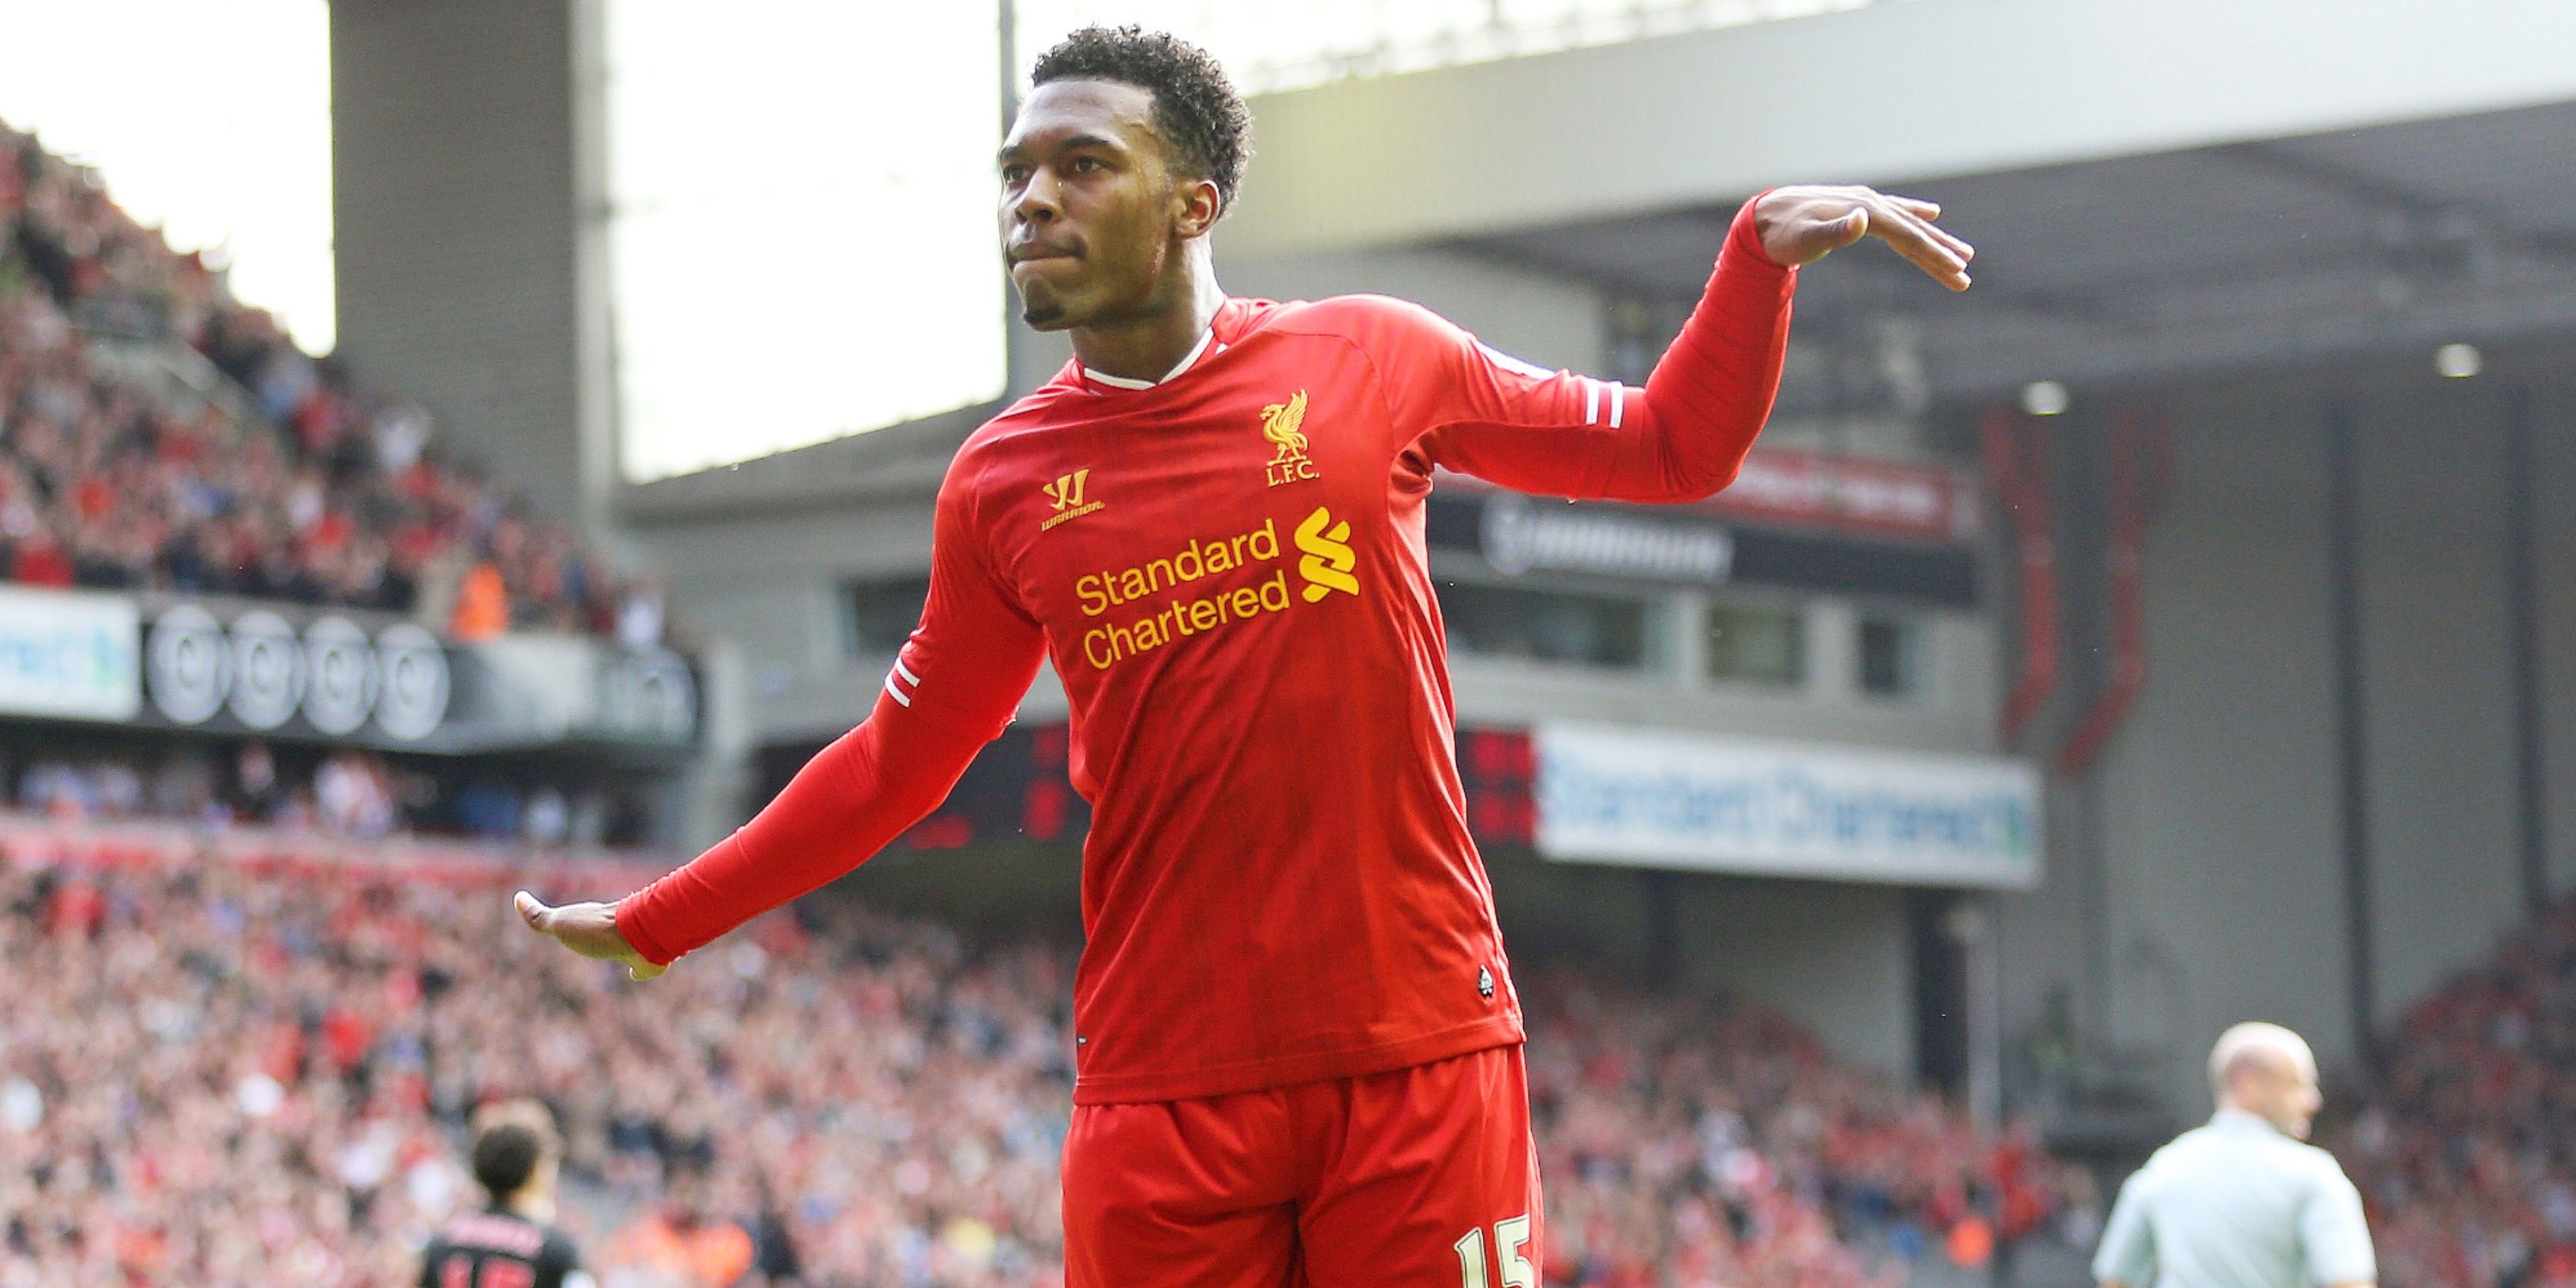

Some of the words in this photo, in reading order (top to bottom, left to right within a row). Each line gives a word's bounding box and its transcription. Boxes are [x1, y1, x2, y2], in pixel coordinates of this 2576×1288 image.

[1266, 459, 1321, 488] L.F.C.
[1076, 518, 1280, 617] Standard
[1084, 569, 1291, 670] Chartered
[1453, 1212, 1534, 1288] 15
